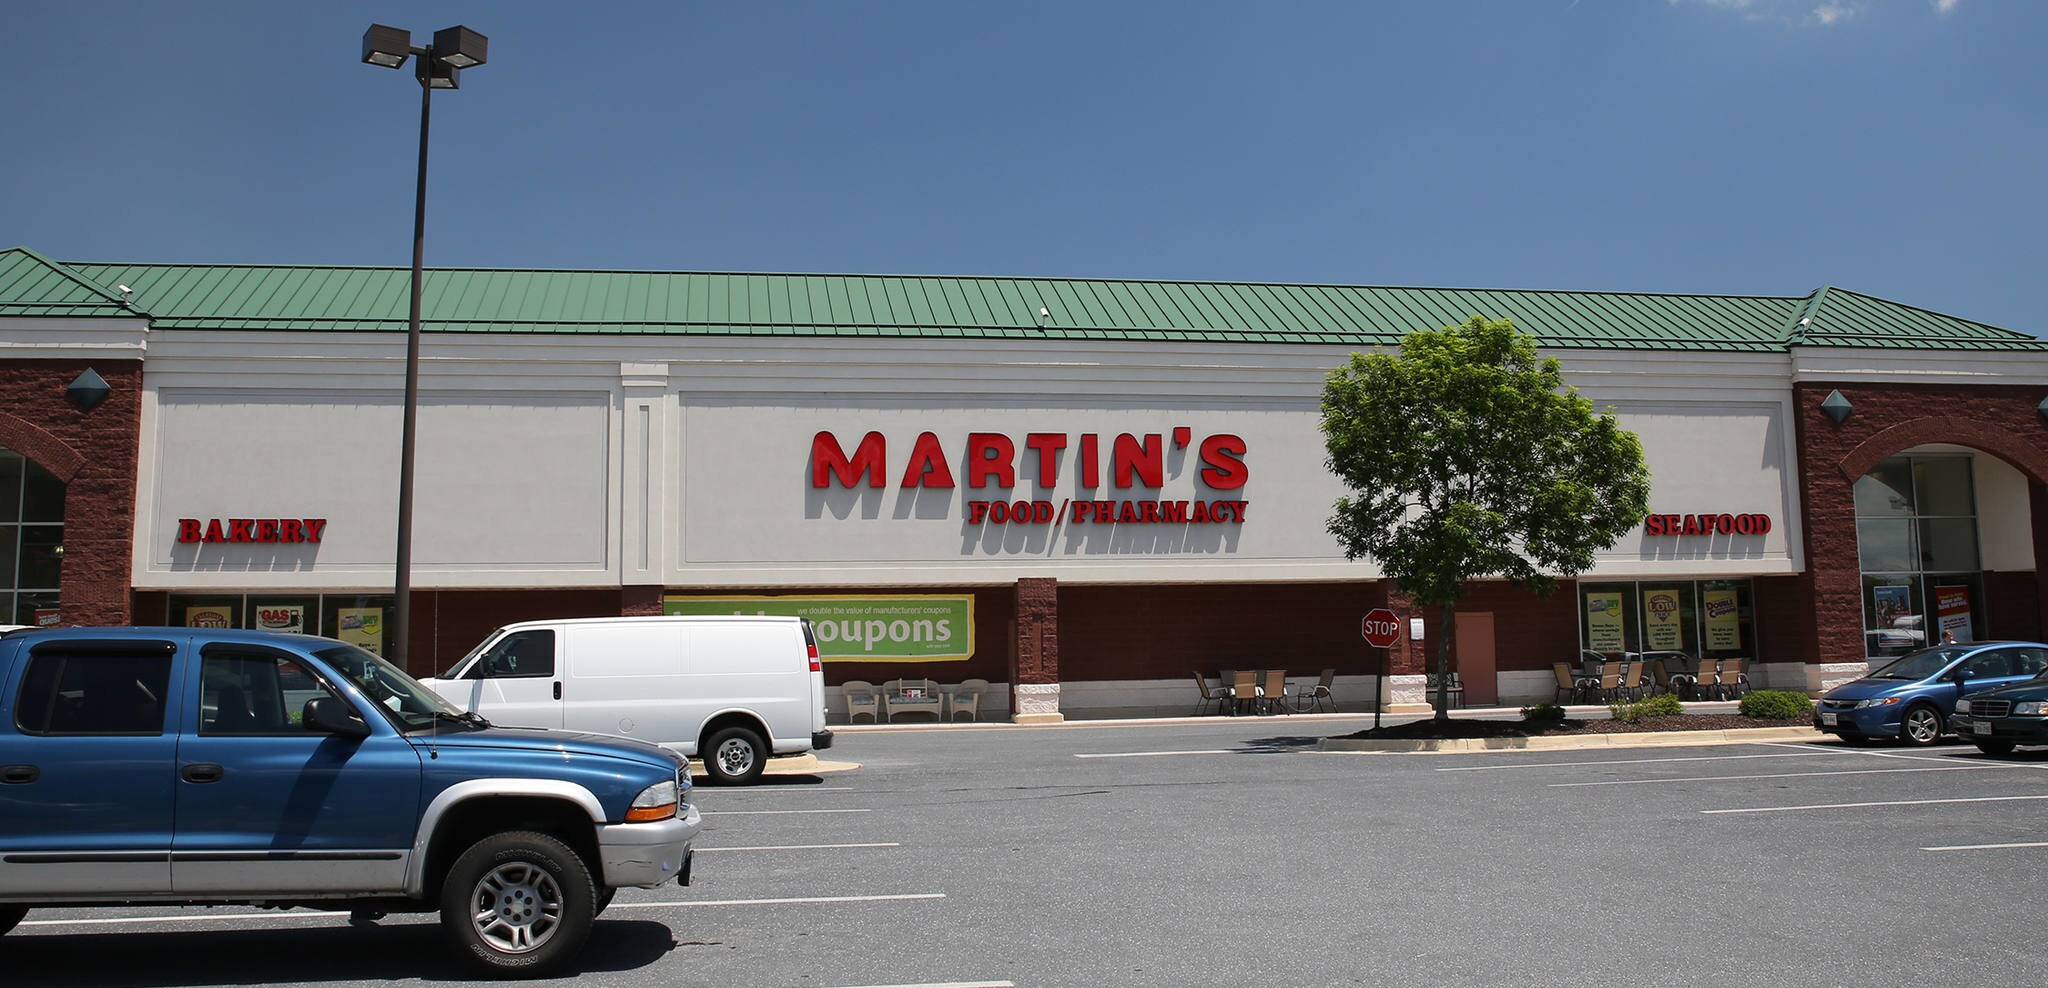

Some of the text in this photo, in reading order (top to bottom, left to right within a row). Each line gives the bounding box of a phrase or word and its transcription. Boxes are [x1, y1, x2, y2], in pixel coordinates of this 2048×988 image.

[812, 426, 1249, 490] MARTIN'S
[968, 499, 1249, 526] FOOD/PHARMACY
[1645, 513, 1772, 536] SEAFOOD
[178, 518, 327, 544] BAKERY
[261, 609, 290, 620] GAS
[809, 607, 832, 615] double
[833, 607, 845, 615] the
[846, 607, 864, 615] value
[865, 606, 872, 615] of
[923, 607, 951, 616] coupons
[811, 618, 951, 651] oupons
[1365, 620, 1399, 636] STOP
[470, 943, 538, 967] MICHELIN
